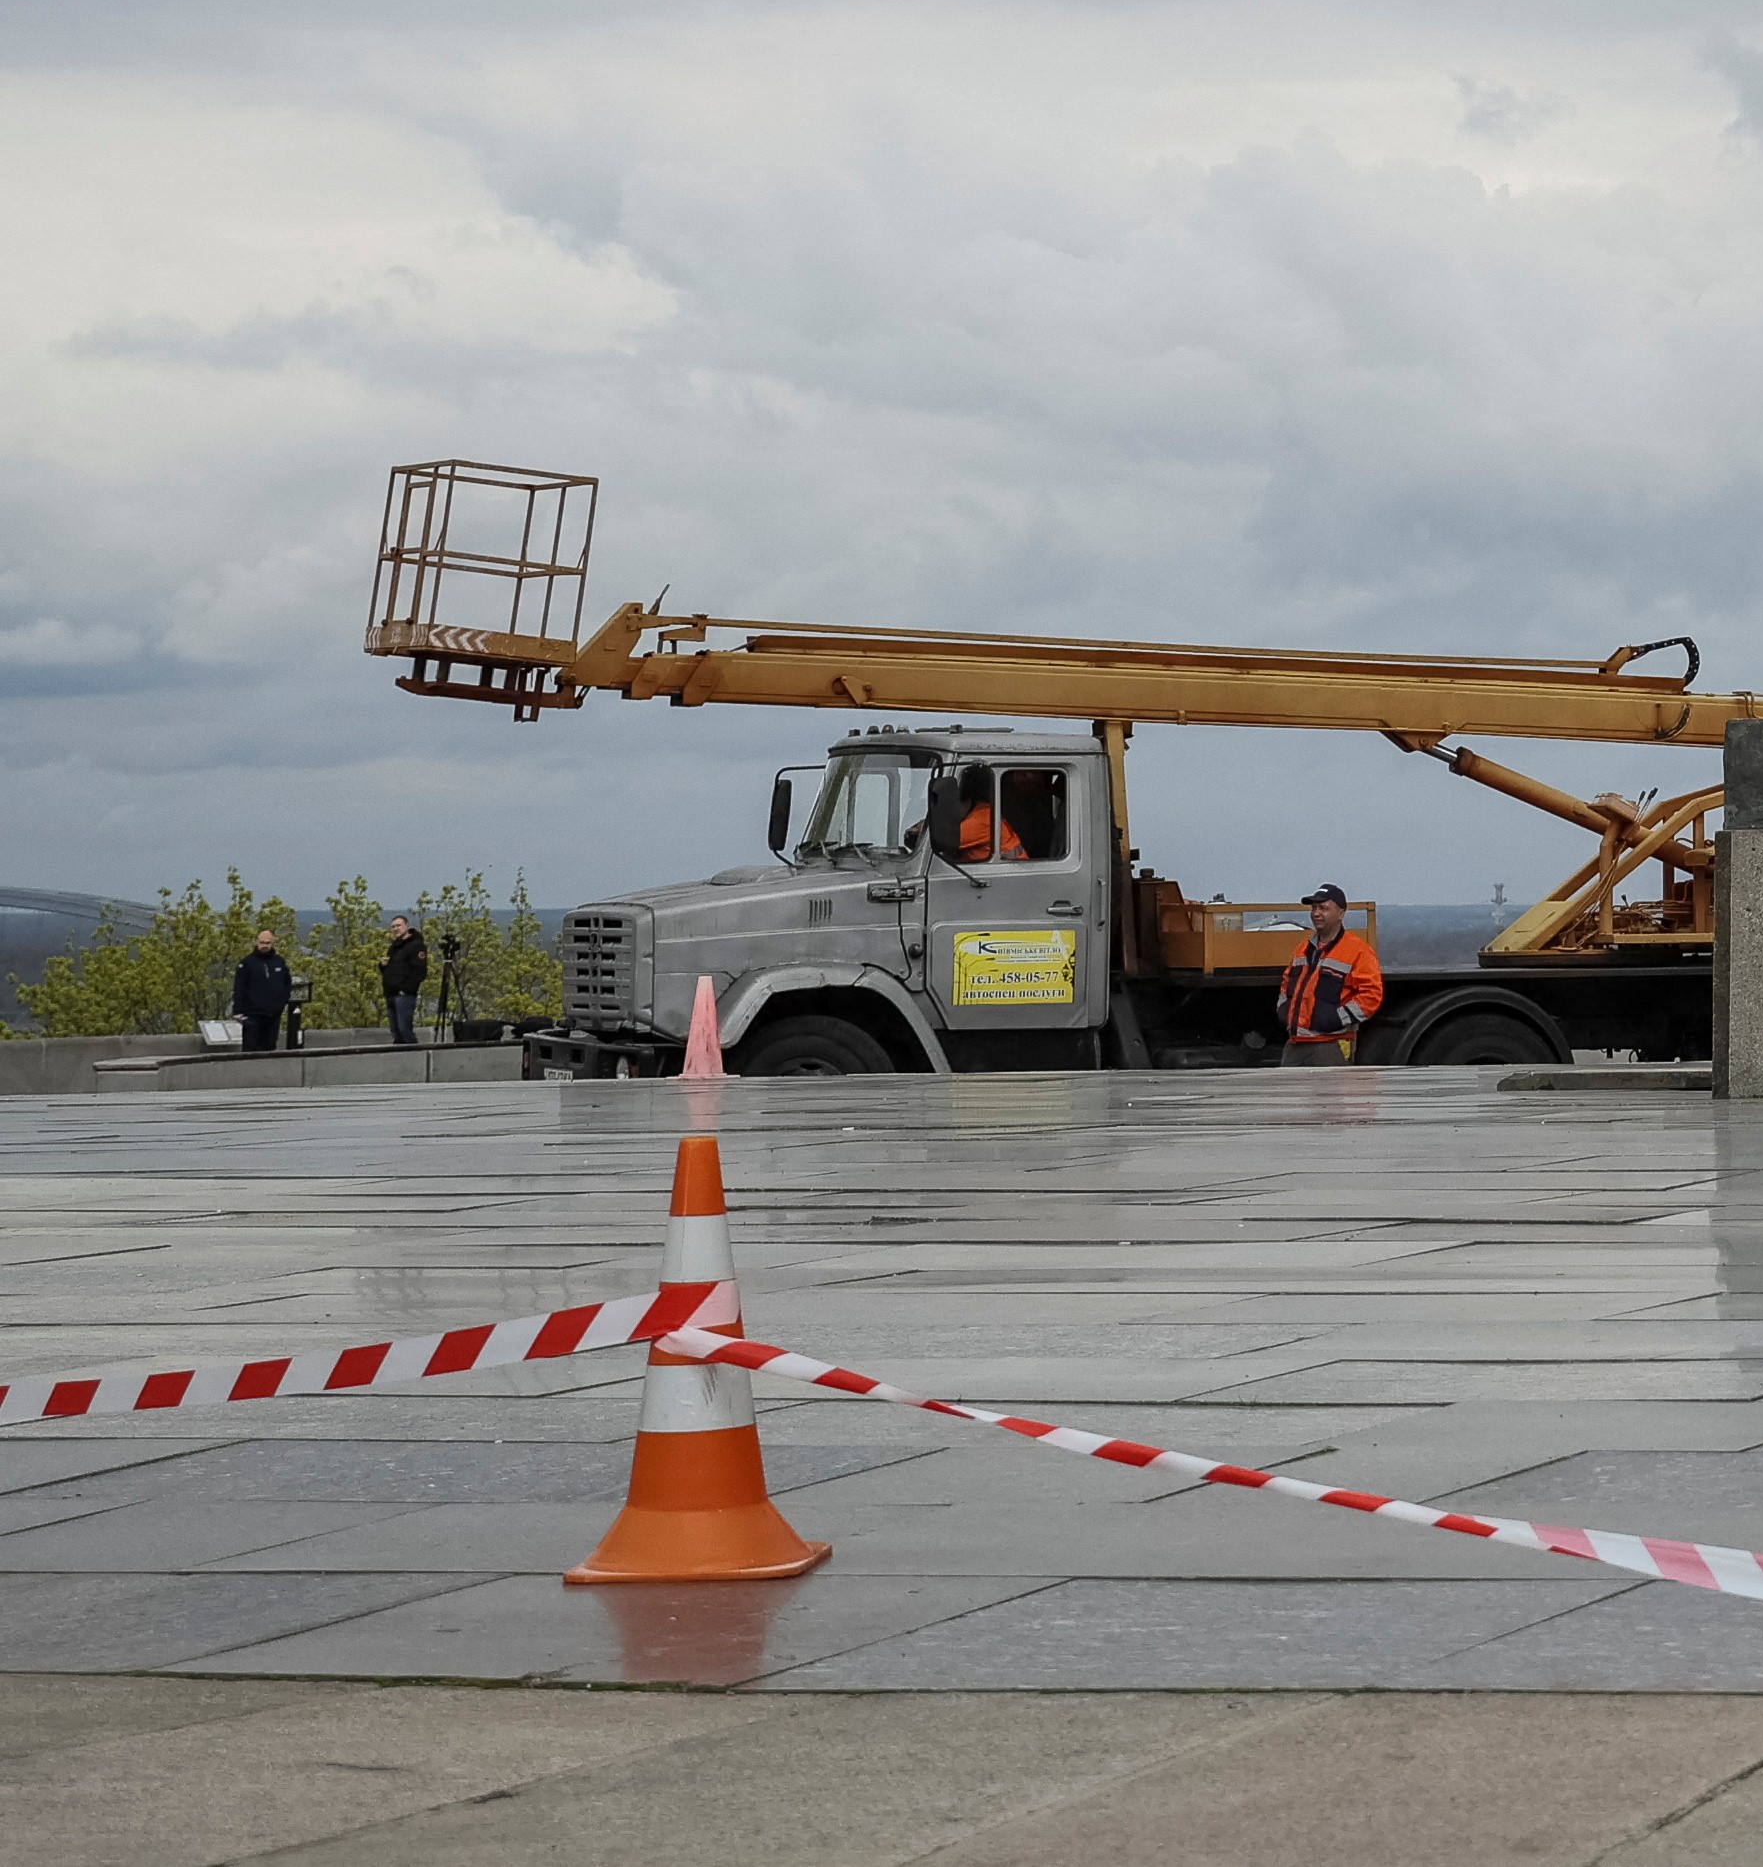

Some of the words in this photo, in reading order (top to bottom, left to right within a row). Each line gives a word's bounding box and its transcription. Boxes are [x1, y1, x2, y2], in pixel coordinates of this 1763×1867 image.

[971, 975, 995, 984] тел.
[1000, 972, 1058, 984] 458-05-77
[1019, 989, 1065, 999] послуги
